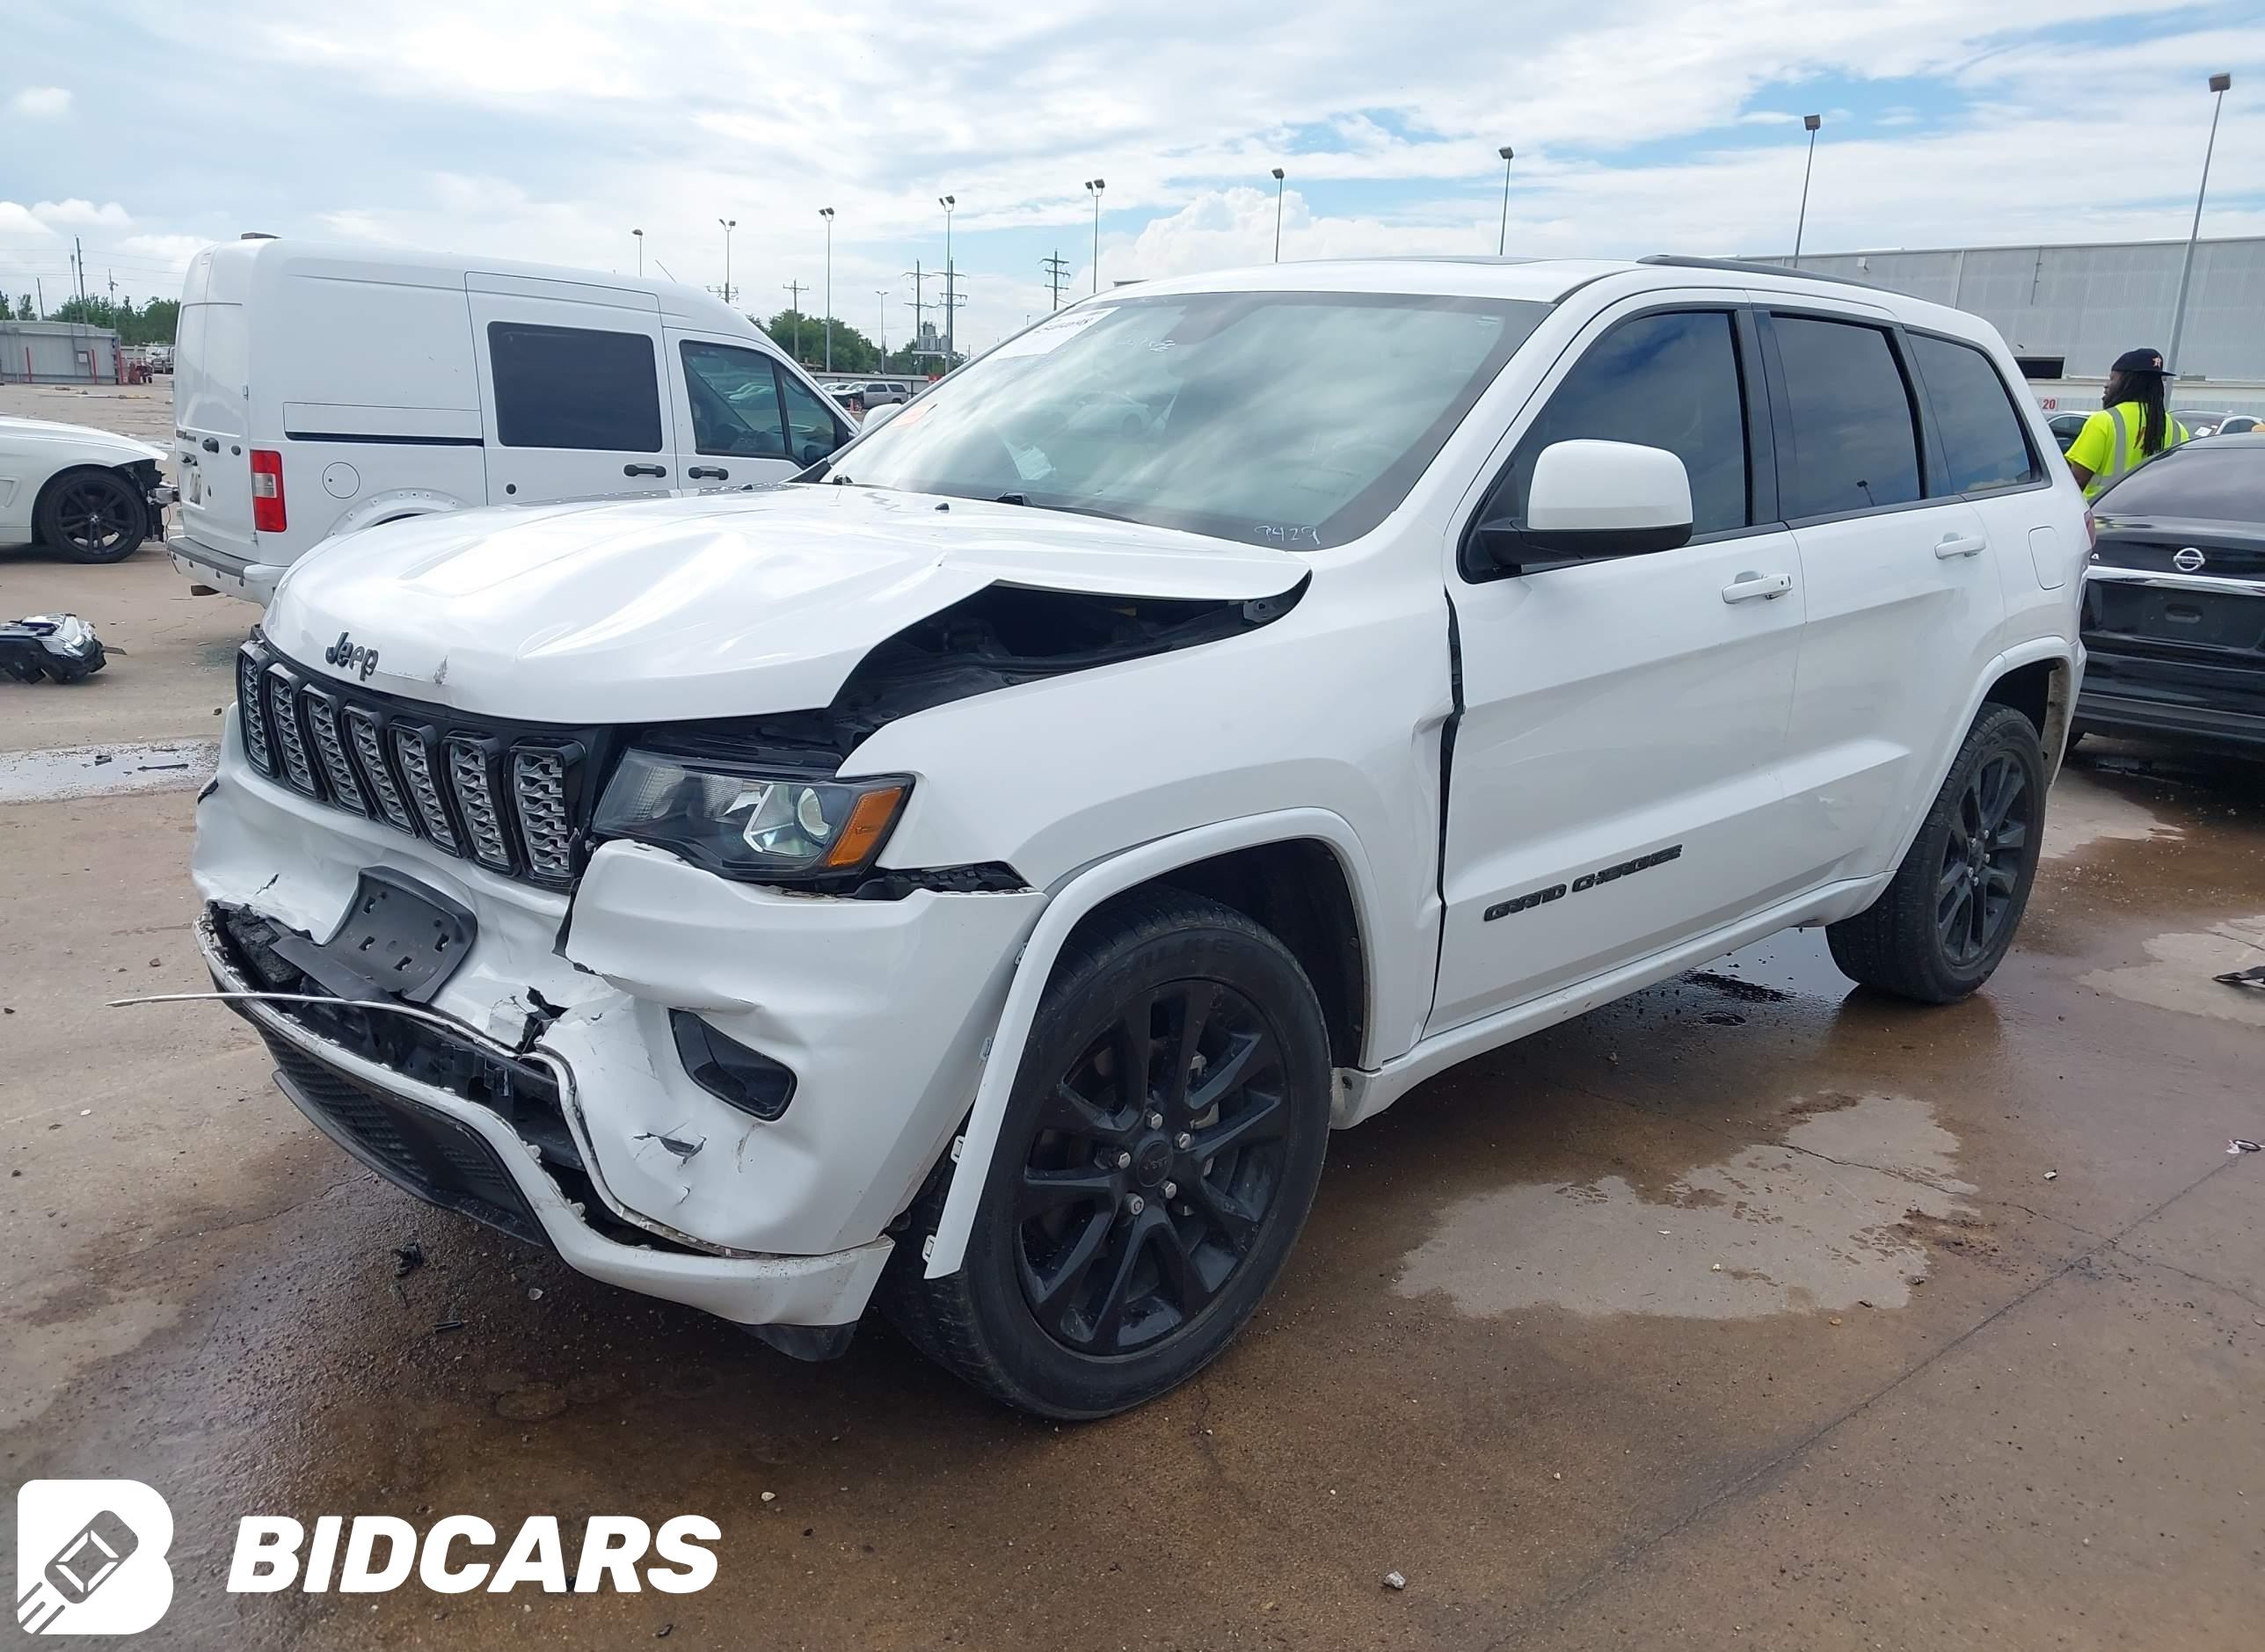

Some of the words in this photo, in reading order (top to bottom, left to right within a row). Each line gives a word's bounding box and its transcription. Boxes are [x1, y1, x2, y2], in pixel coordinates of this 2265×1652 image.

[2042, 398, 2057, 410] 20
[325, 631, 379, 682] Jeep
[1483, 883, 1567, 921] GRAND
